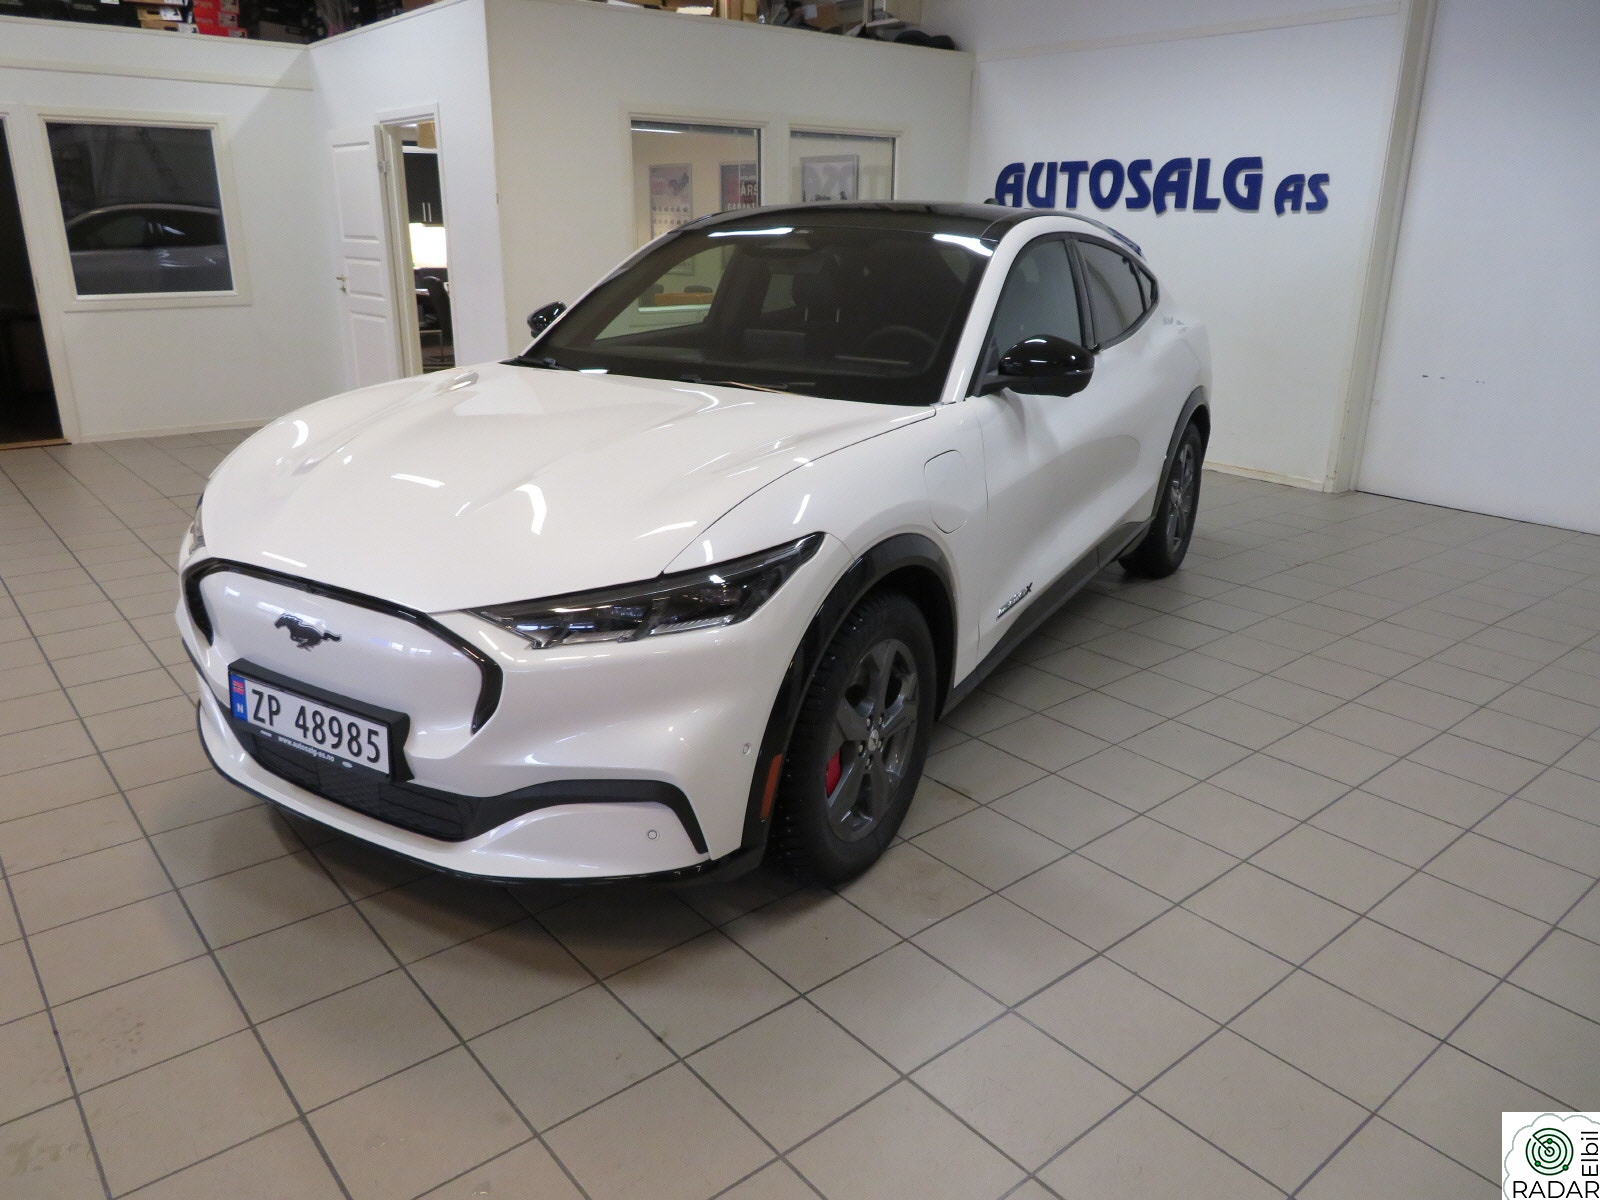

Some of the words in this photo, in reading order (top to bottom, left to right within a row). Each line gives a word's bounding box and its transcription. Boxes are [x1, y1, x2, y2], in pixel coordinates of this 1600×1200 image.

[994, 156, 1263, 215] AUTOSALG
[1274, 173, 1329, 216] AS
[236, 702, 244, 714] N
[252, 688, 281, 726] ZP
[294, 705, 381, 764] 48985
